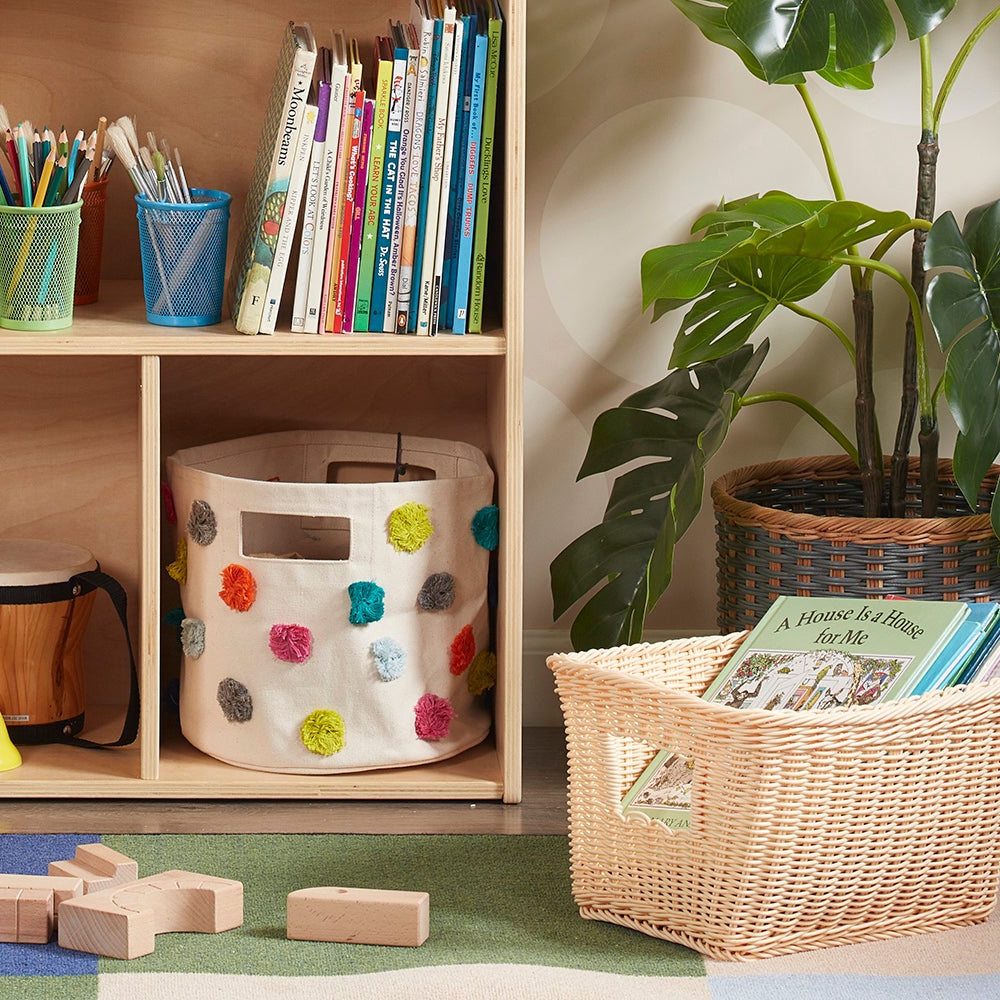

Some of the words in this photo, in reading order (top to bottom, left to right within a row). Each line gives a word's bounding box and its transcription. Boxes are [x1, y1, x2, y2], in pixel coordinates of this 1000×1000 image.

[422, 31, 431, 54] Rubin
[491, 31, 499, 48] Lisa
[418, 70, 427, 102] Salmieri
[474, 72, 480, 82] My
[379, 79, 387, 107] SPARKLE
[278, 86, 305, 167] Moonbeams
[413, 111, 423, 149] DRAGONS
[437, 117, 445, 130] My
[388, 140, 397, 158] THE
[400, 129, 409, 154] Orange
[434, 131, 444, 160] Father's
[372, 156, 380, 181] LEARN
[399, 156, 407, 171] You
[411, 155, 419, 177] LOVE
[468, 141, 477, 175] DIGGERS
[481, 136, 492, 179] Ducklings
[387, 162, 396, 181] CAT
[432, 162, 441, 181] Shop
[308, 184, 317, 207] LOOK
[346, 171, 355, 202] Cooking?
[369, 184, 377, 207] YOUR
[385, 184, 392, 194] IN
[408, 183, 417, 211] TACOS
[466, 183, 474, 204] DUMP
[480, 182, 488, 203] Love
[287, 190, 297, 215] KIPPER
[307, 209, 314, 219] AT
[383, 197, 392, 214] THE
[367, 209, 375, 226] ABC
[381, 218, 391, 239] HAT
[393, 202, 402, 240] Halloween,
[463, 207, 472, 237] TRUCKS
[280, 235, 288, 250] THE
[301, 222, 314, 255] Colors
[380, 246, 388, 257] Dr.
[391, 243, 399, 266] Amber
[377, 258, 387, 277] Seuss
[388, 268, 397, 296] Brown?
[474, 262, 483, 297] Random
[251, 295, 260, 305] F
[472, 298, 481, 324] House
[774, 617, 790, 633] A
[795, 609, 854, 627] House
[854, 605, 872, 621] Is
[871, 611, 883, 622] a
[881, 609, 925, 641] House
[813, 627, 842, 644] for
[839, 629, 869, 645] Me
